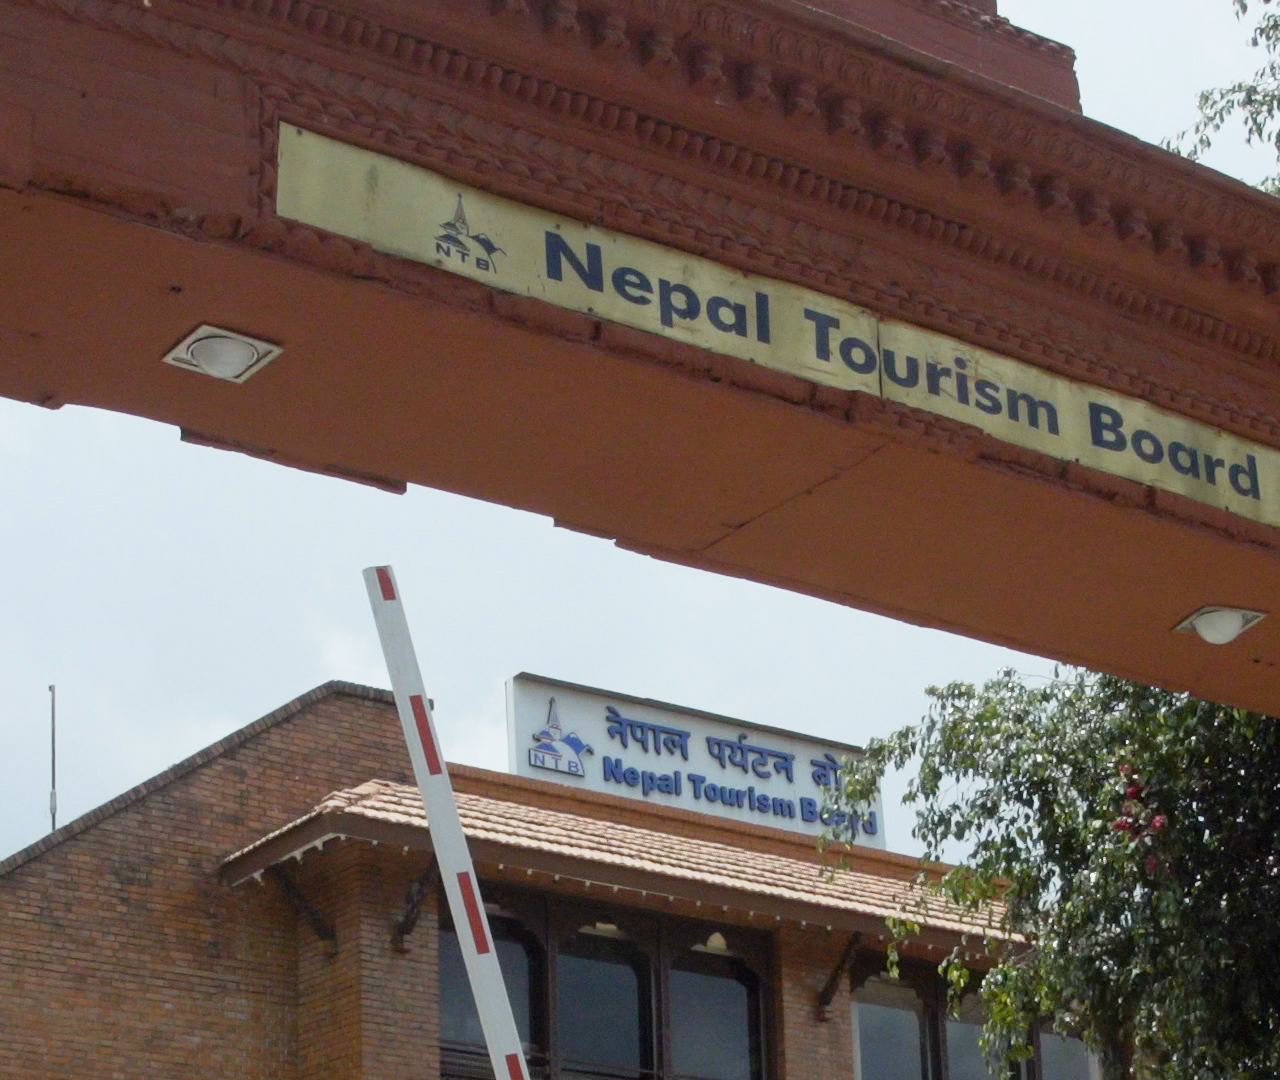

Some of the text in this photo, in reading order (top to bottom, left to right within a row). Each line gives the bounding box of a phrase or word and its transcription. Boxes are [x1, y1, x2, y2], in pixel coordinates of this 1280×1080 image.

[435, 242, 490, 272] NTB
[545, 231, 1261, 500] Nepal Tourism Board
[534, 753, 580, 774] NTB
[605, 705, 691, 761] नेपाल
[705, 733, 796, 783] पर्यटन
[603, 756, 682, 797] Nepal
[687, 773, 796, 819] Tourism
